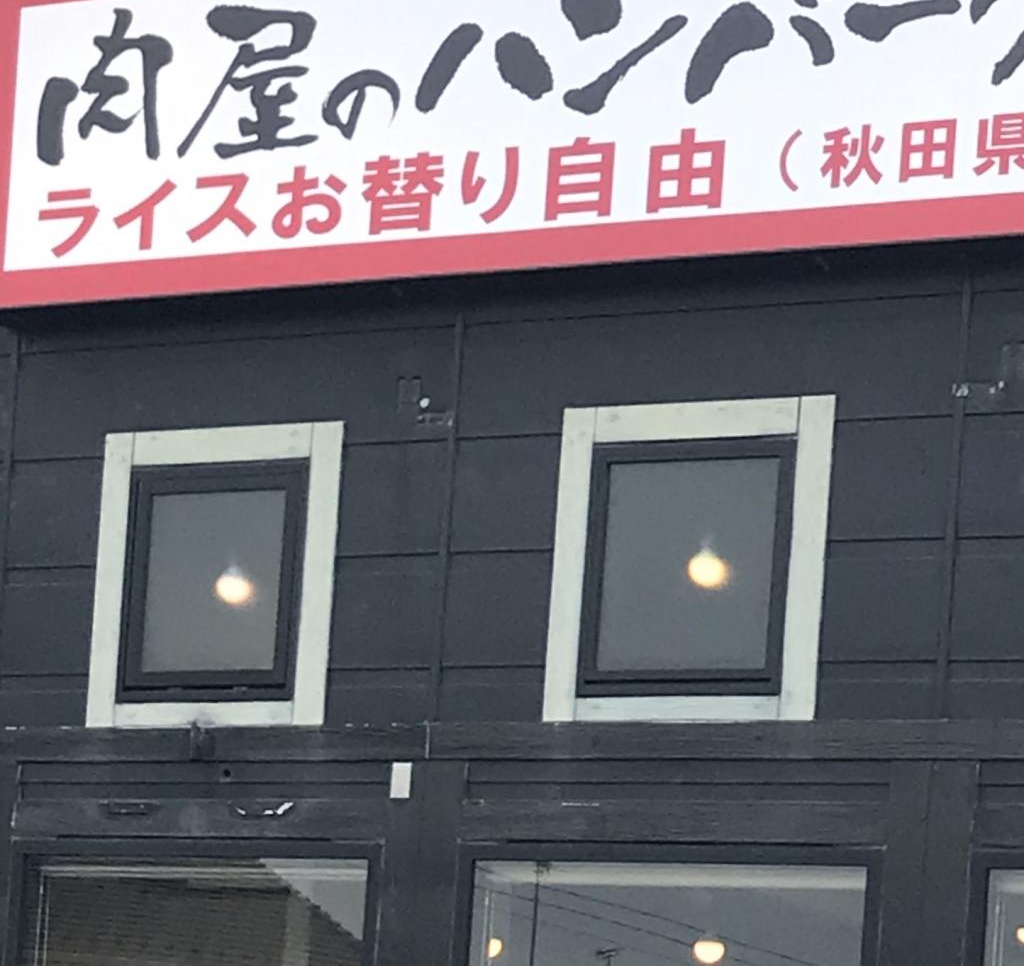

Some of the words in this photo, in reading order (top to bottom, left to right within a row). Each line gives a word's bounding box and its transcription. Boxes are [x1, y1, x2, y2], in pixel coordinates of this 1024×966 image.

[37, 127, 727, 259] ライスお替り自由
